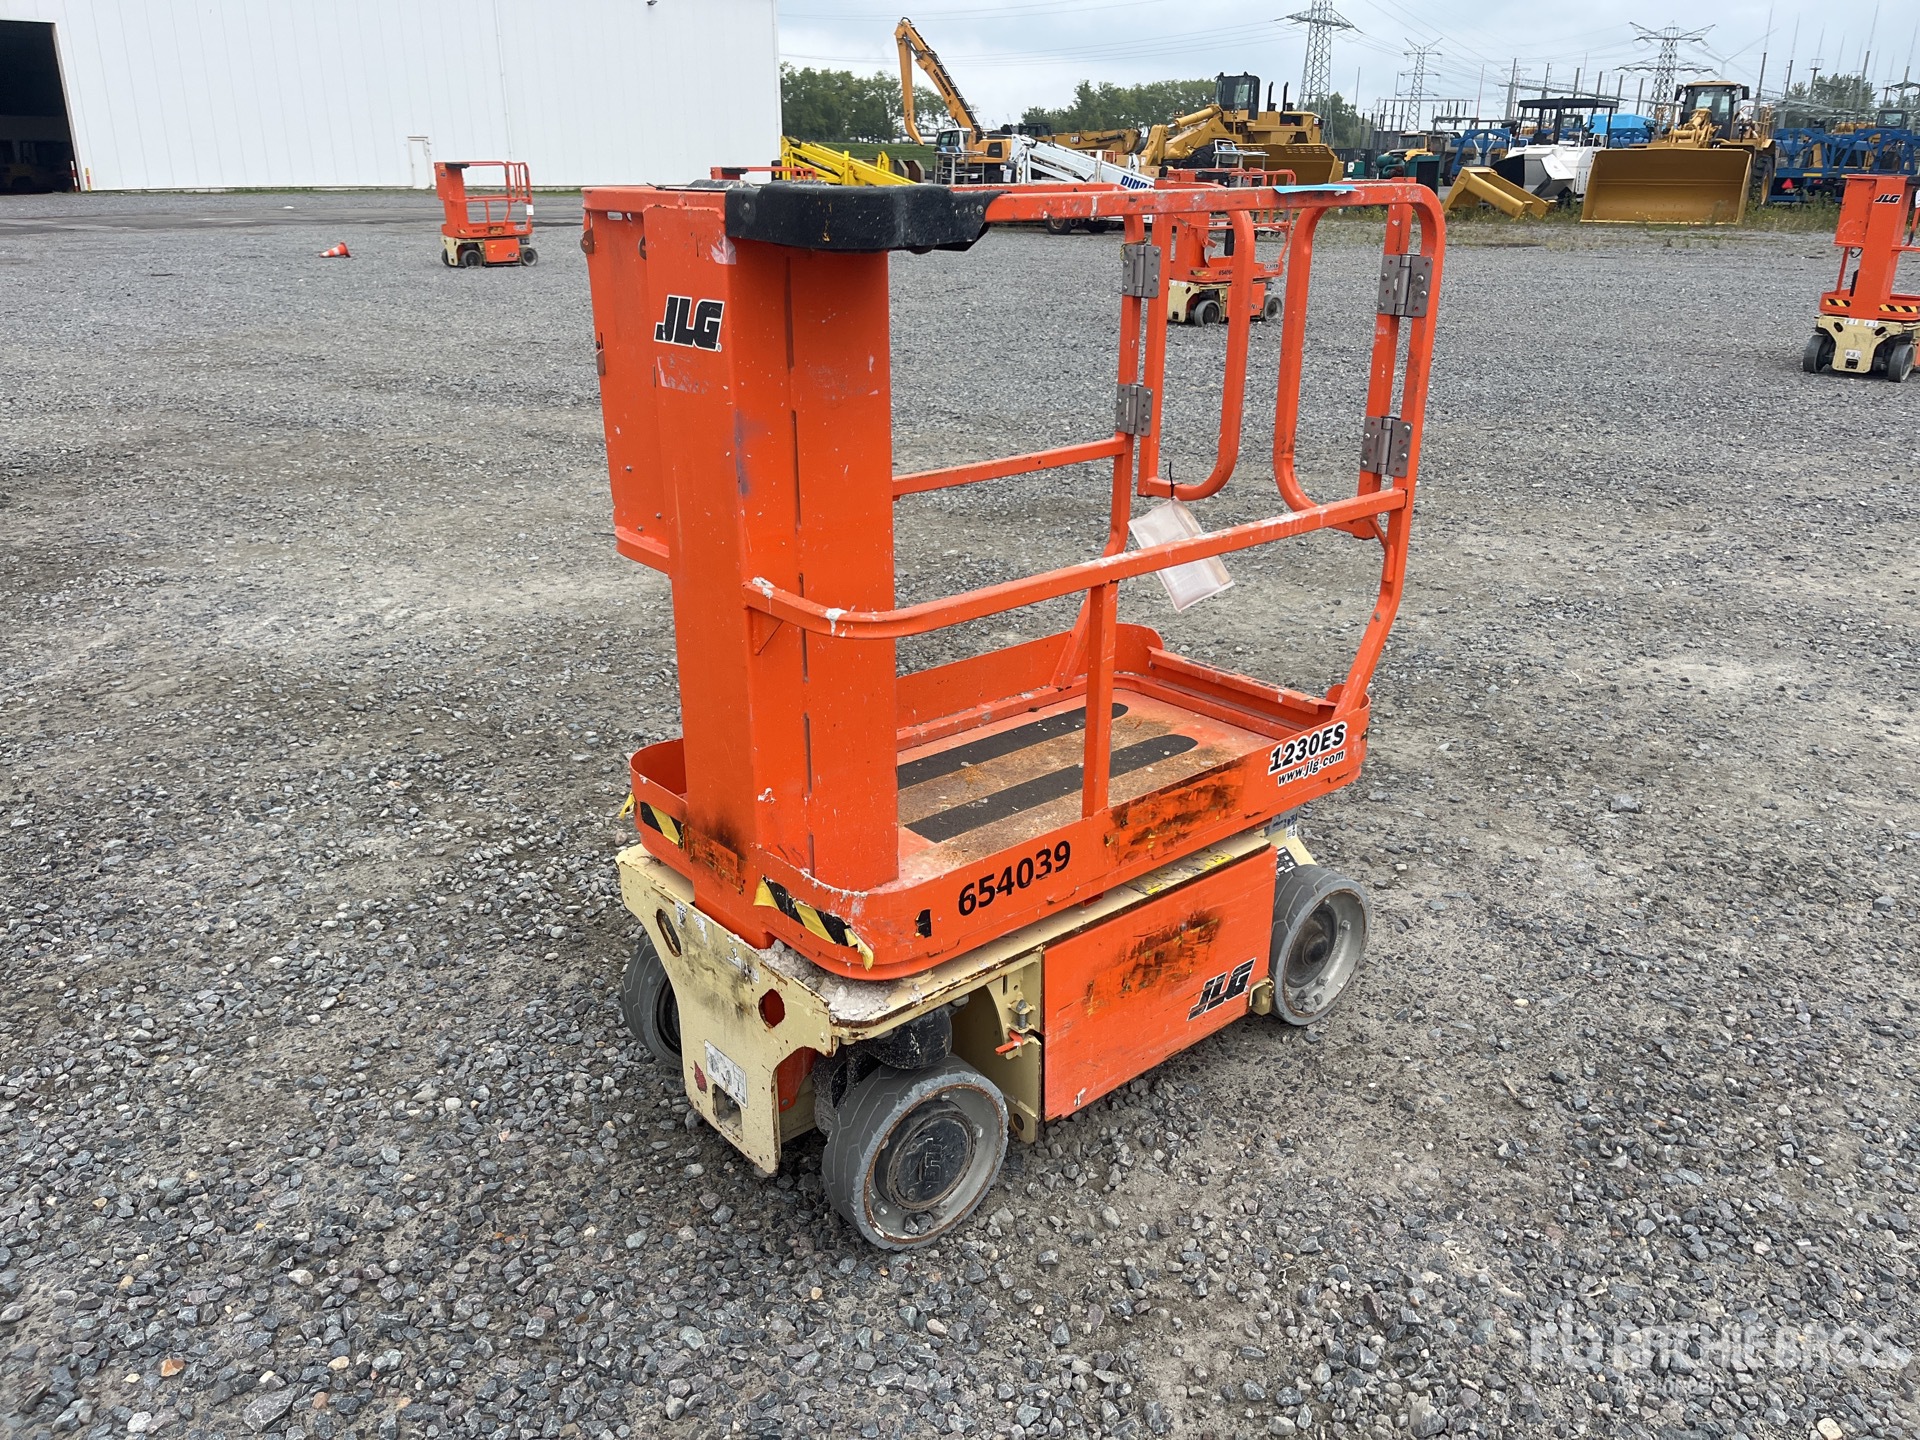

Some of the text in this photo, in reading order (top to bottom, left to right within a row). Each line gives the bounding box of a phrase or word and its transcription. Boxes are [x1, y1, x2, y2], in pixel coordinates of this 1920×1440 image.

[1874, 194, 1901, 203] JLG
[654, 295, 724, 352] JLG
[1269, 723, 1346, 773] 1230ES
[1278, 750, 1345, 785] www.jlg.com
[958, 840, 1071, 917] 654039
[1187, 957, 1256, 1021] JLG
